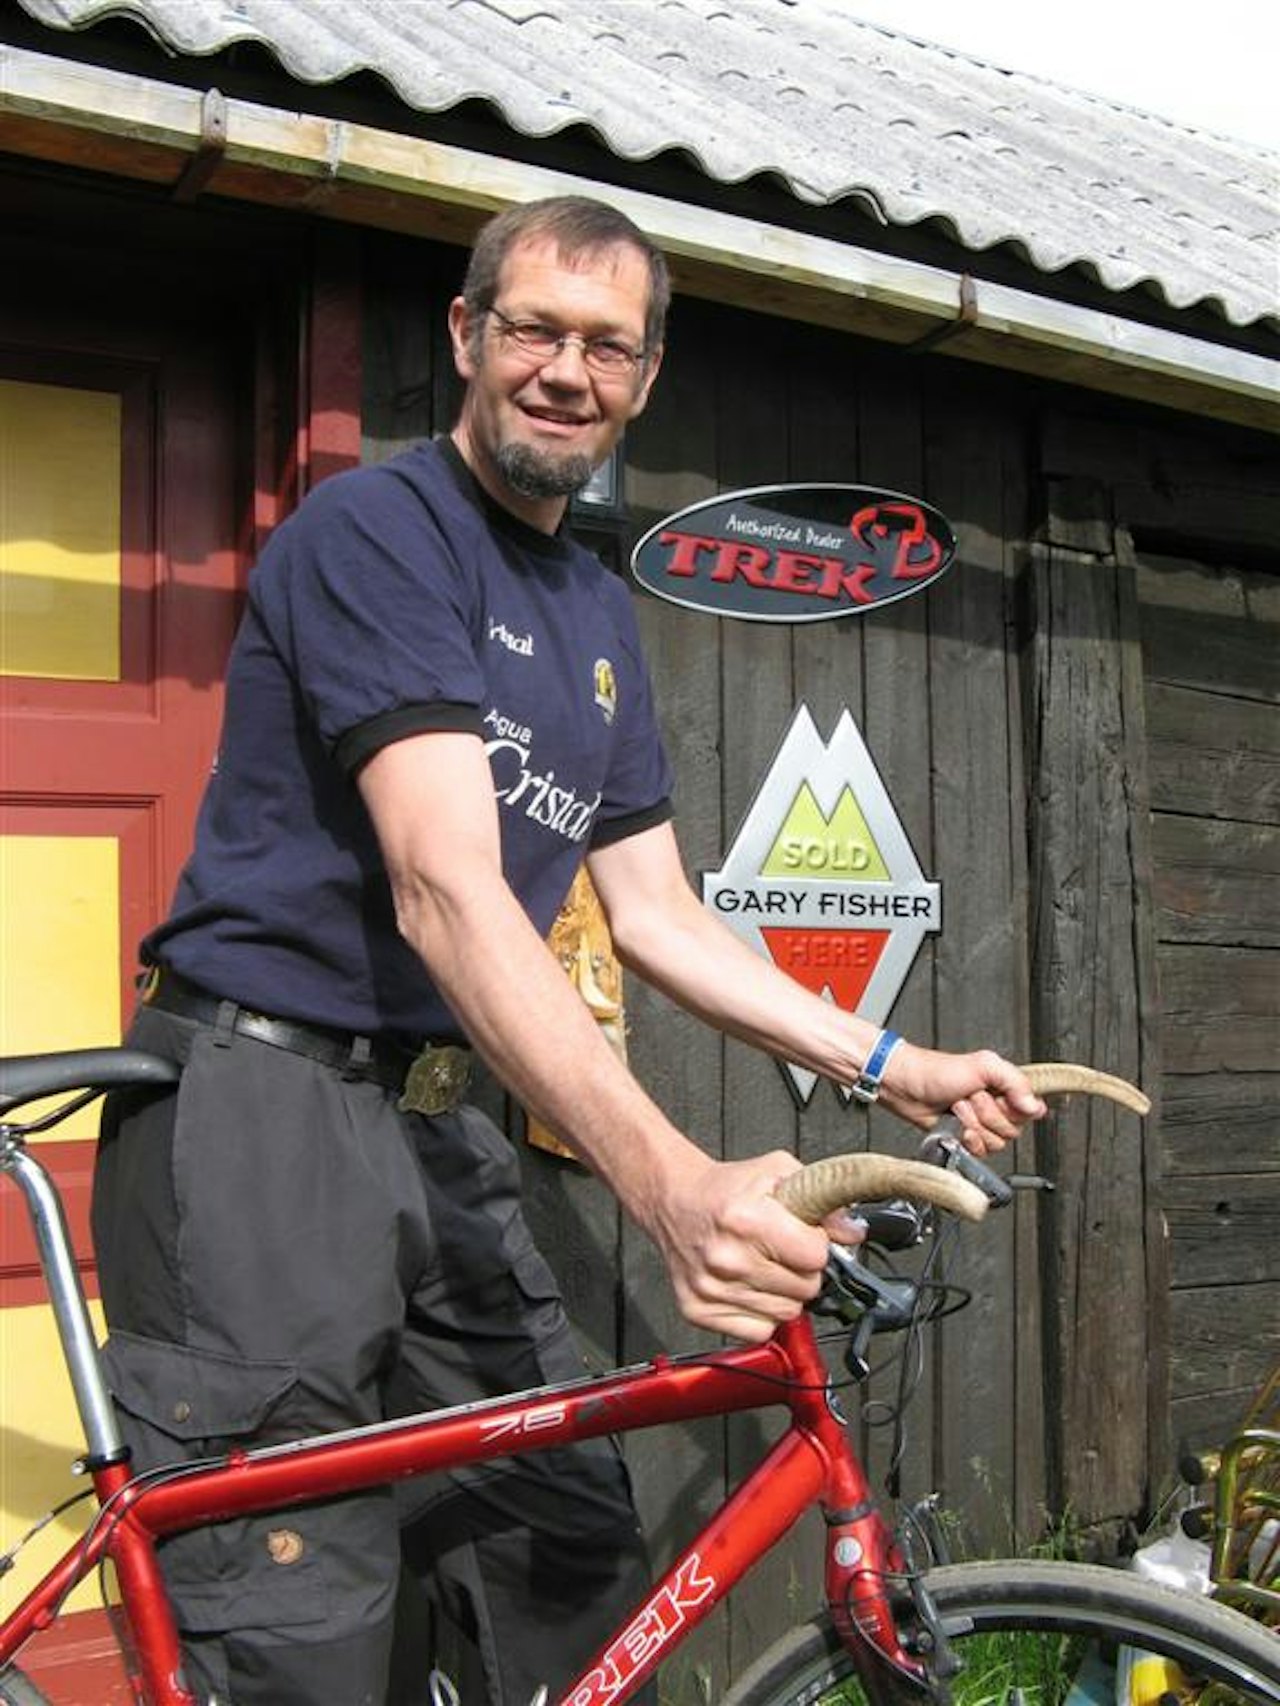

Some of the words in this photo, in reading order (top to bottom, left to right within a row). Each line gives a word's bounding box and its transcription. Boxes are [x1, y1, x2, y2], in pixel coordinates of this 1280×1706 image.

[726, 513, 800, 541] Authorized
[806, 527, 845, 549] Dealer
[659, 531, 878, 605] TREK
[484, 708, 533, 743] Agua
[781, 834, 871, 872] SOLD
[714, 888, 805, 915] GARY
[818, 891, 932, 918] FISHER
[786, 936, 871, 968] HERE
[479, 1402, 566, 1443] 7.6
